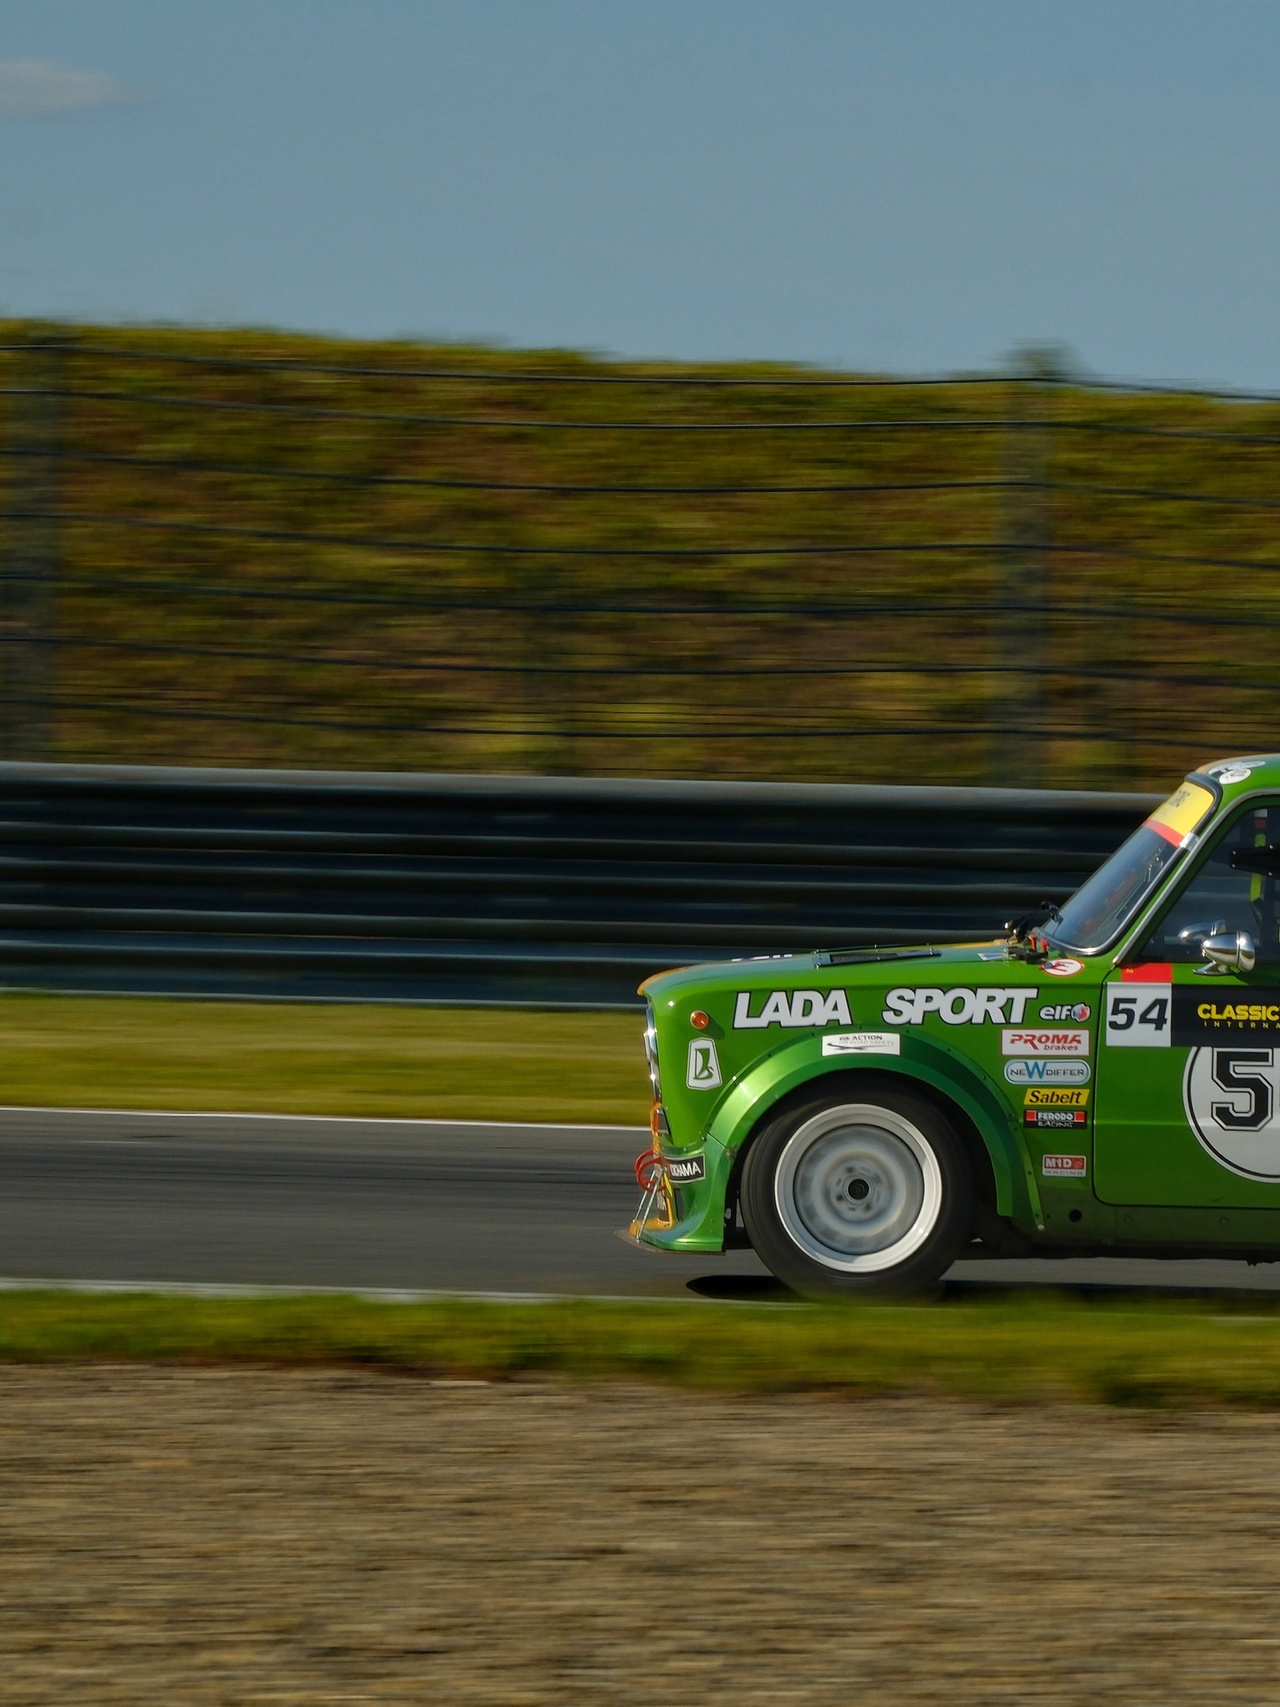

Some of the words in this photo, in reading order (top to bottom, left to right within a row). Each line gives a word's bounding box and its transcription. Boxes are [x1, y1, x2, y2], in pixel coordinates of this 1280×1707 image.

[732, 988, 853, 1028] LADA
[881, 987, 1038, 1025] SPORT
[1108, 998, 1169, 1031] 54
[1010, 1034, 1082, 1050] PROMA
[1029, 1090, 1083, 1104] Sabelt
[1037, 1112, 1074, 1120] FERODO
